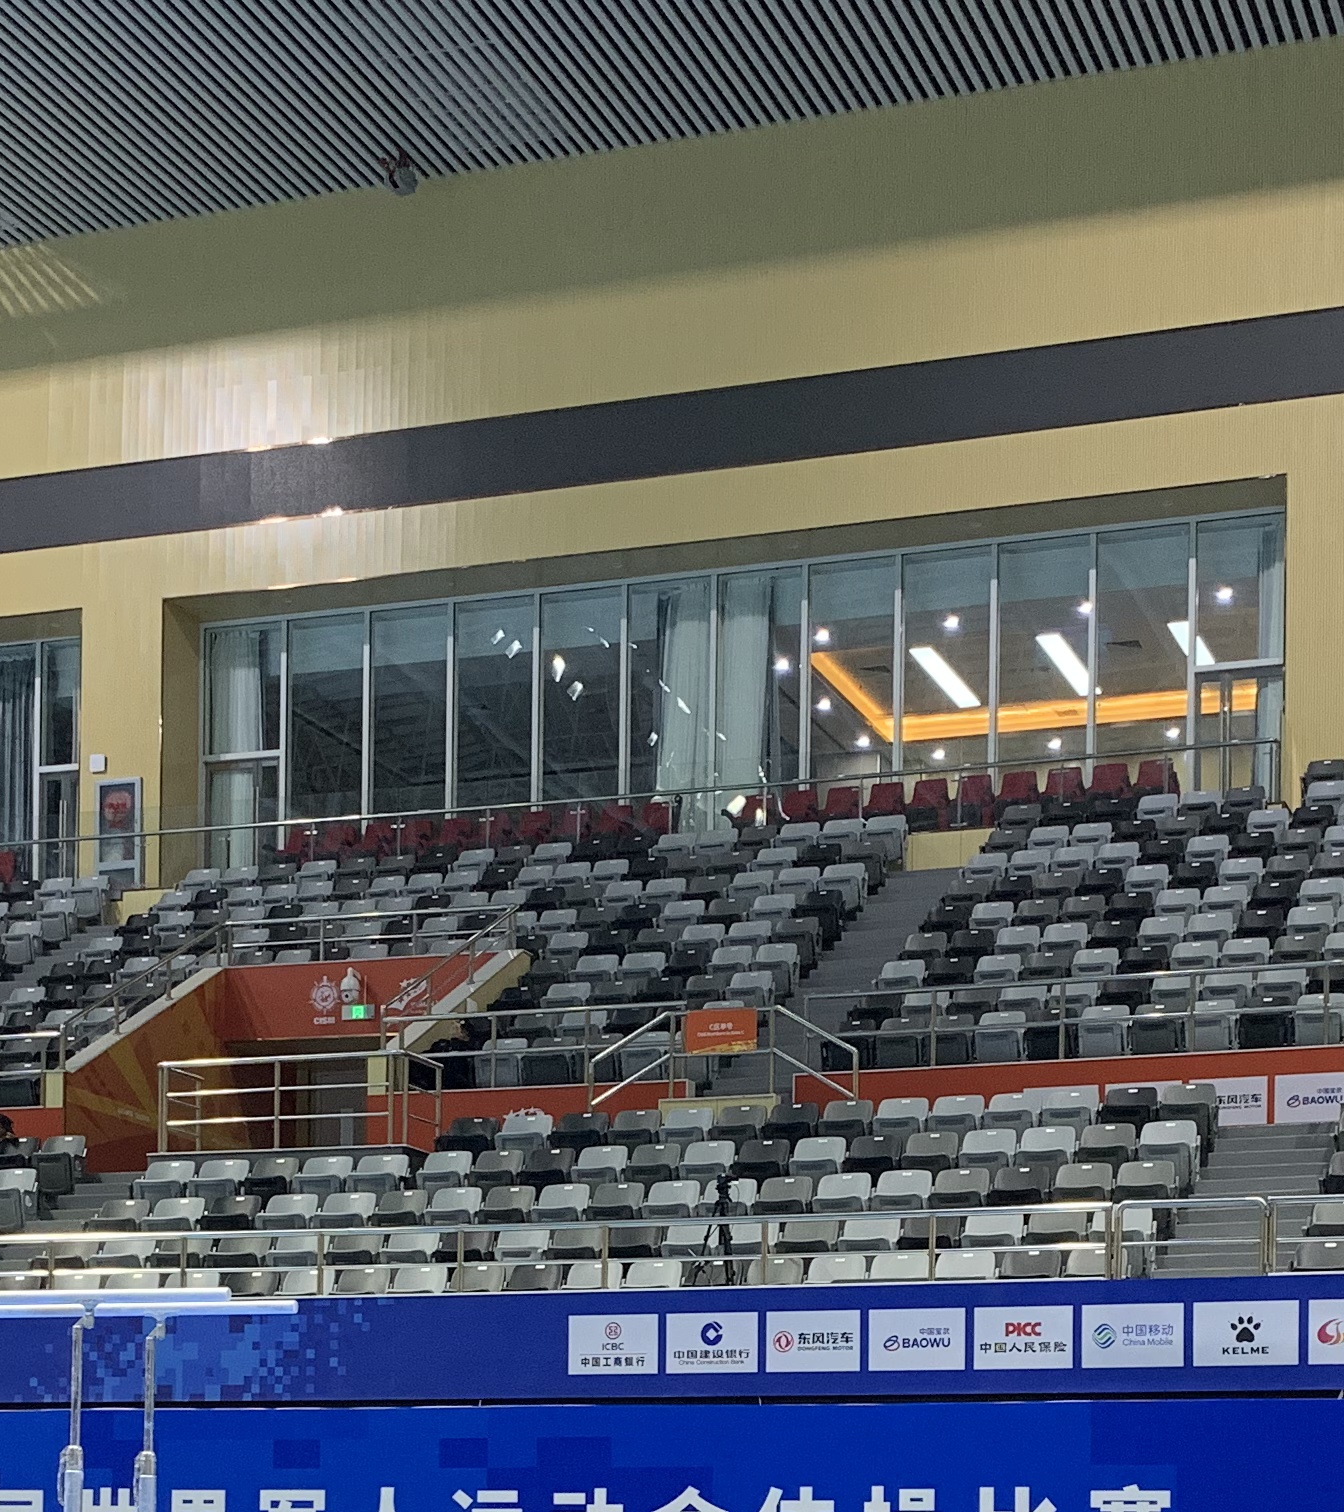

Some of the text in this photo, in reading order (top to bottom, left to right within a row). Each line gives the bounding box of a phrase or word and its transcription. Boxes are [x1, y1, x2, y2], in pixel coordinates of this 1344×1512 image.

[1005, 1322, 1042, 1337] PICC
[1122, 1324, 1174, 1336] 中国移动
[797, 1332, 854, 1345] 东风汽车
[902, 1337, 951, 1349] BAOWU
[602, 1343, 624, 1351] ICBC
[980, 1341, 1067, 1353] 中国人民保险
[1222, 1346, 1270, 1355] KELME
[673, 1348, 750, 1360] 中国建设银行
[580, 1356, 645, 1367] 中国工商银行
